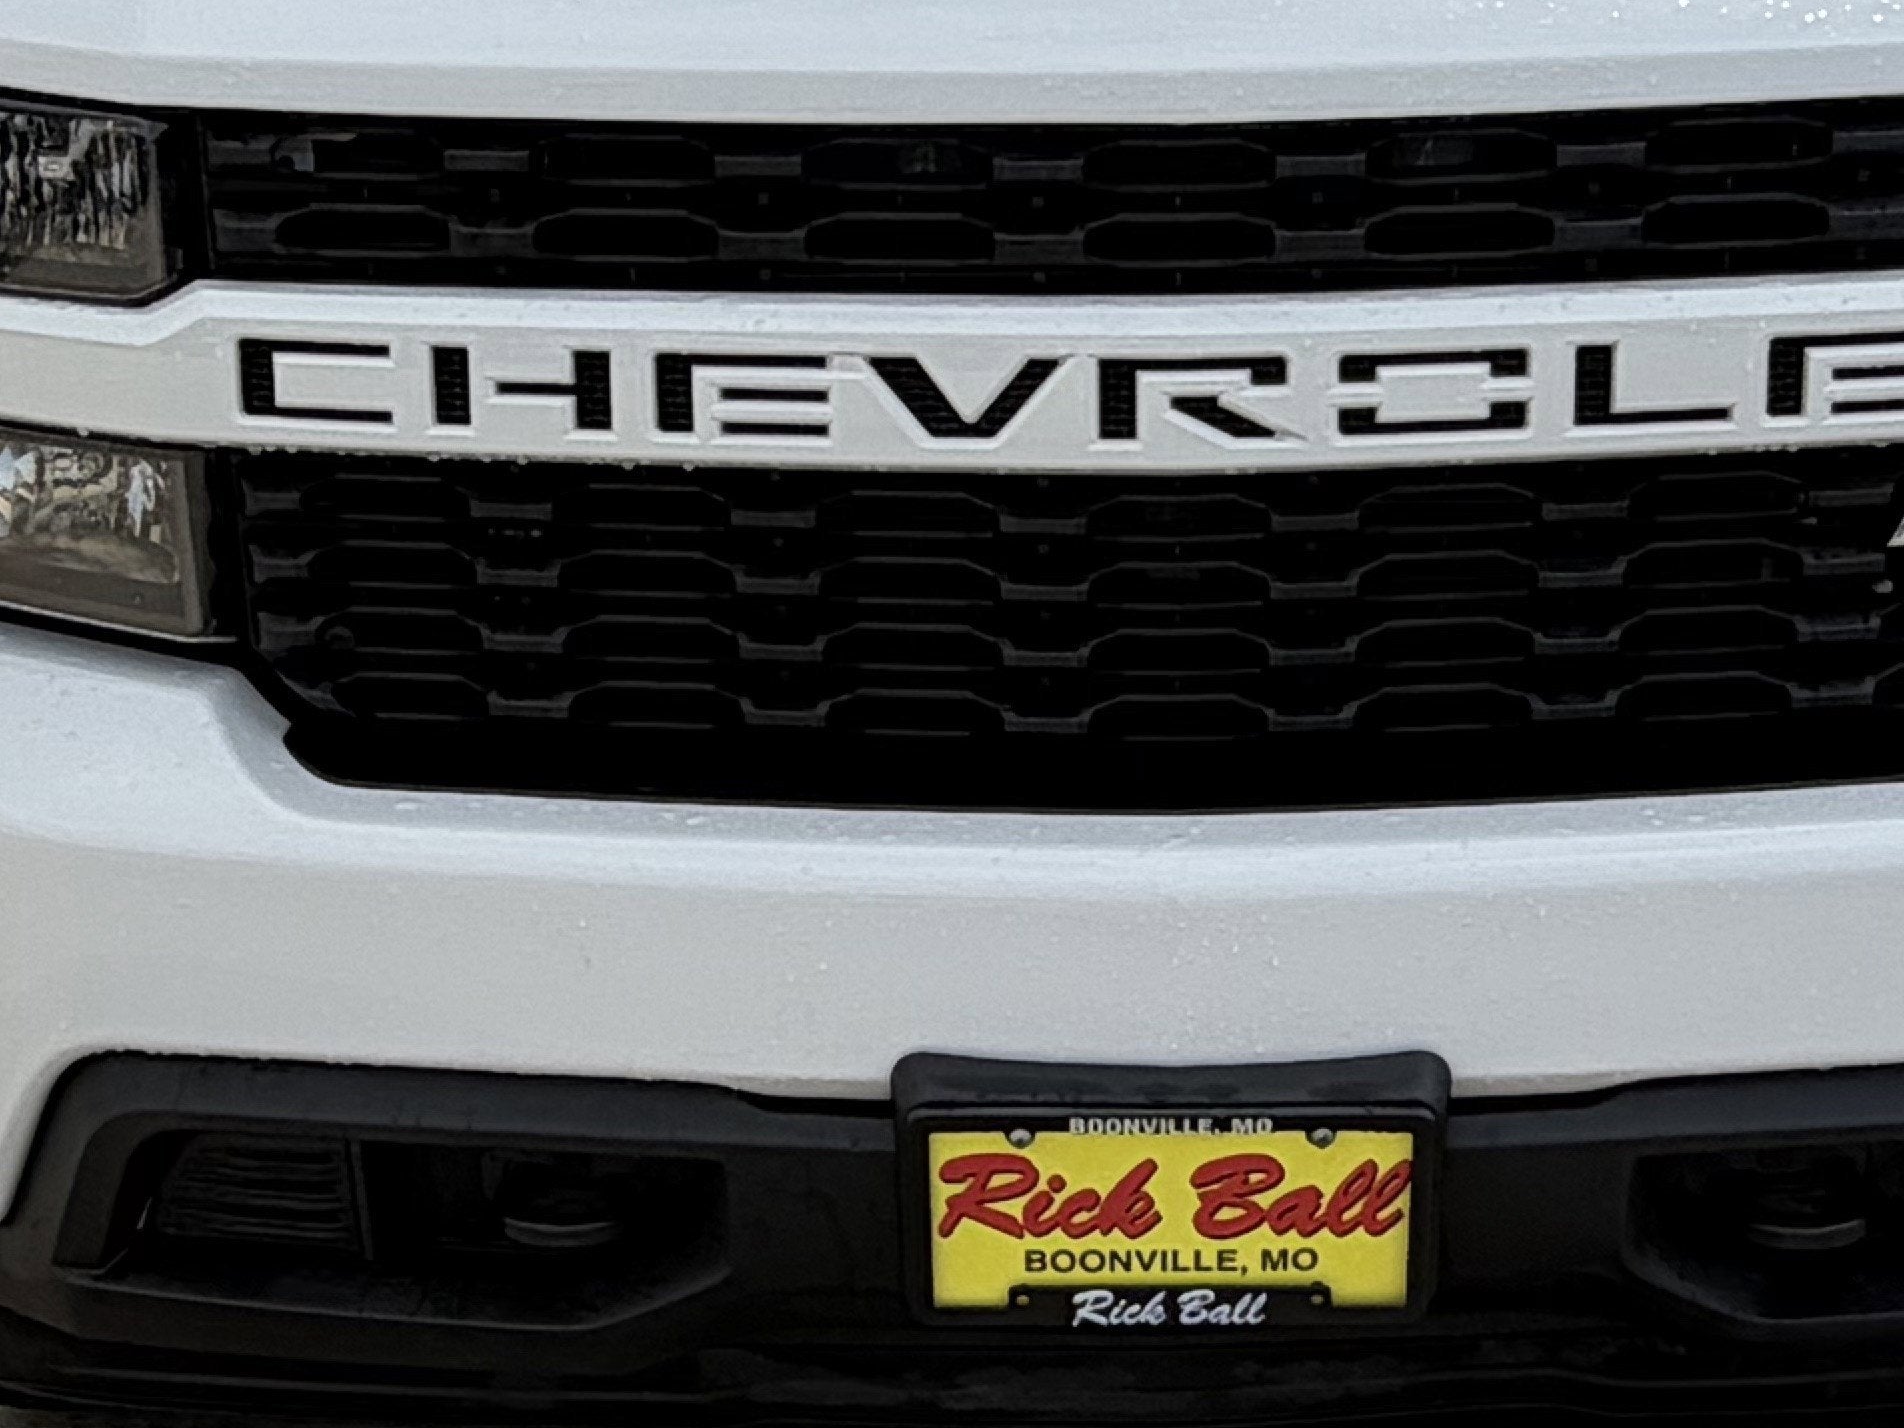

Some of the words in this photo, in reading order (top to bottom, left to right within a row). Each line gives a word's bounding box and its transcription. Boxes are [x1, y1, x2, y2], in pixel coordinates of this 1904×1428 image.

[1069, 1117, 1222, 1135] BOONVILLE,
[1232, 1117, 1272, 1134] MO
[938, 1152, 1163, 1239] Rick
[1190, 1152, 1413, 1239] Ball
[1024, 1248, 1249, 1276] BOONVILLE,
[1261, 1247, 1319, 1271] MO
[1071, 1290, 1167, 1327] Rick
[1178, 1291, 1268, 1324] Ball
